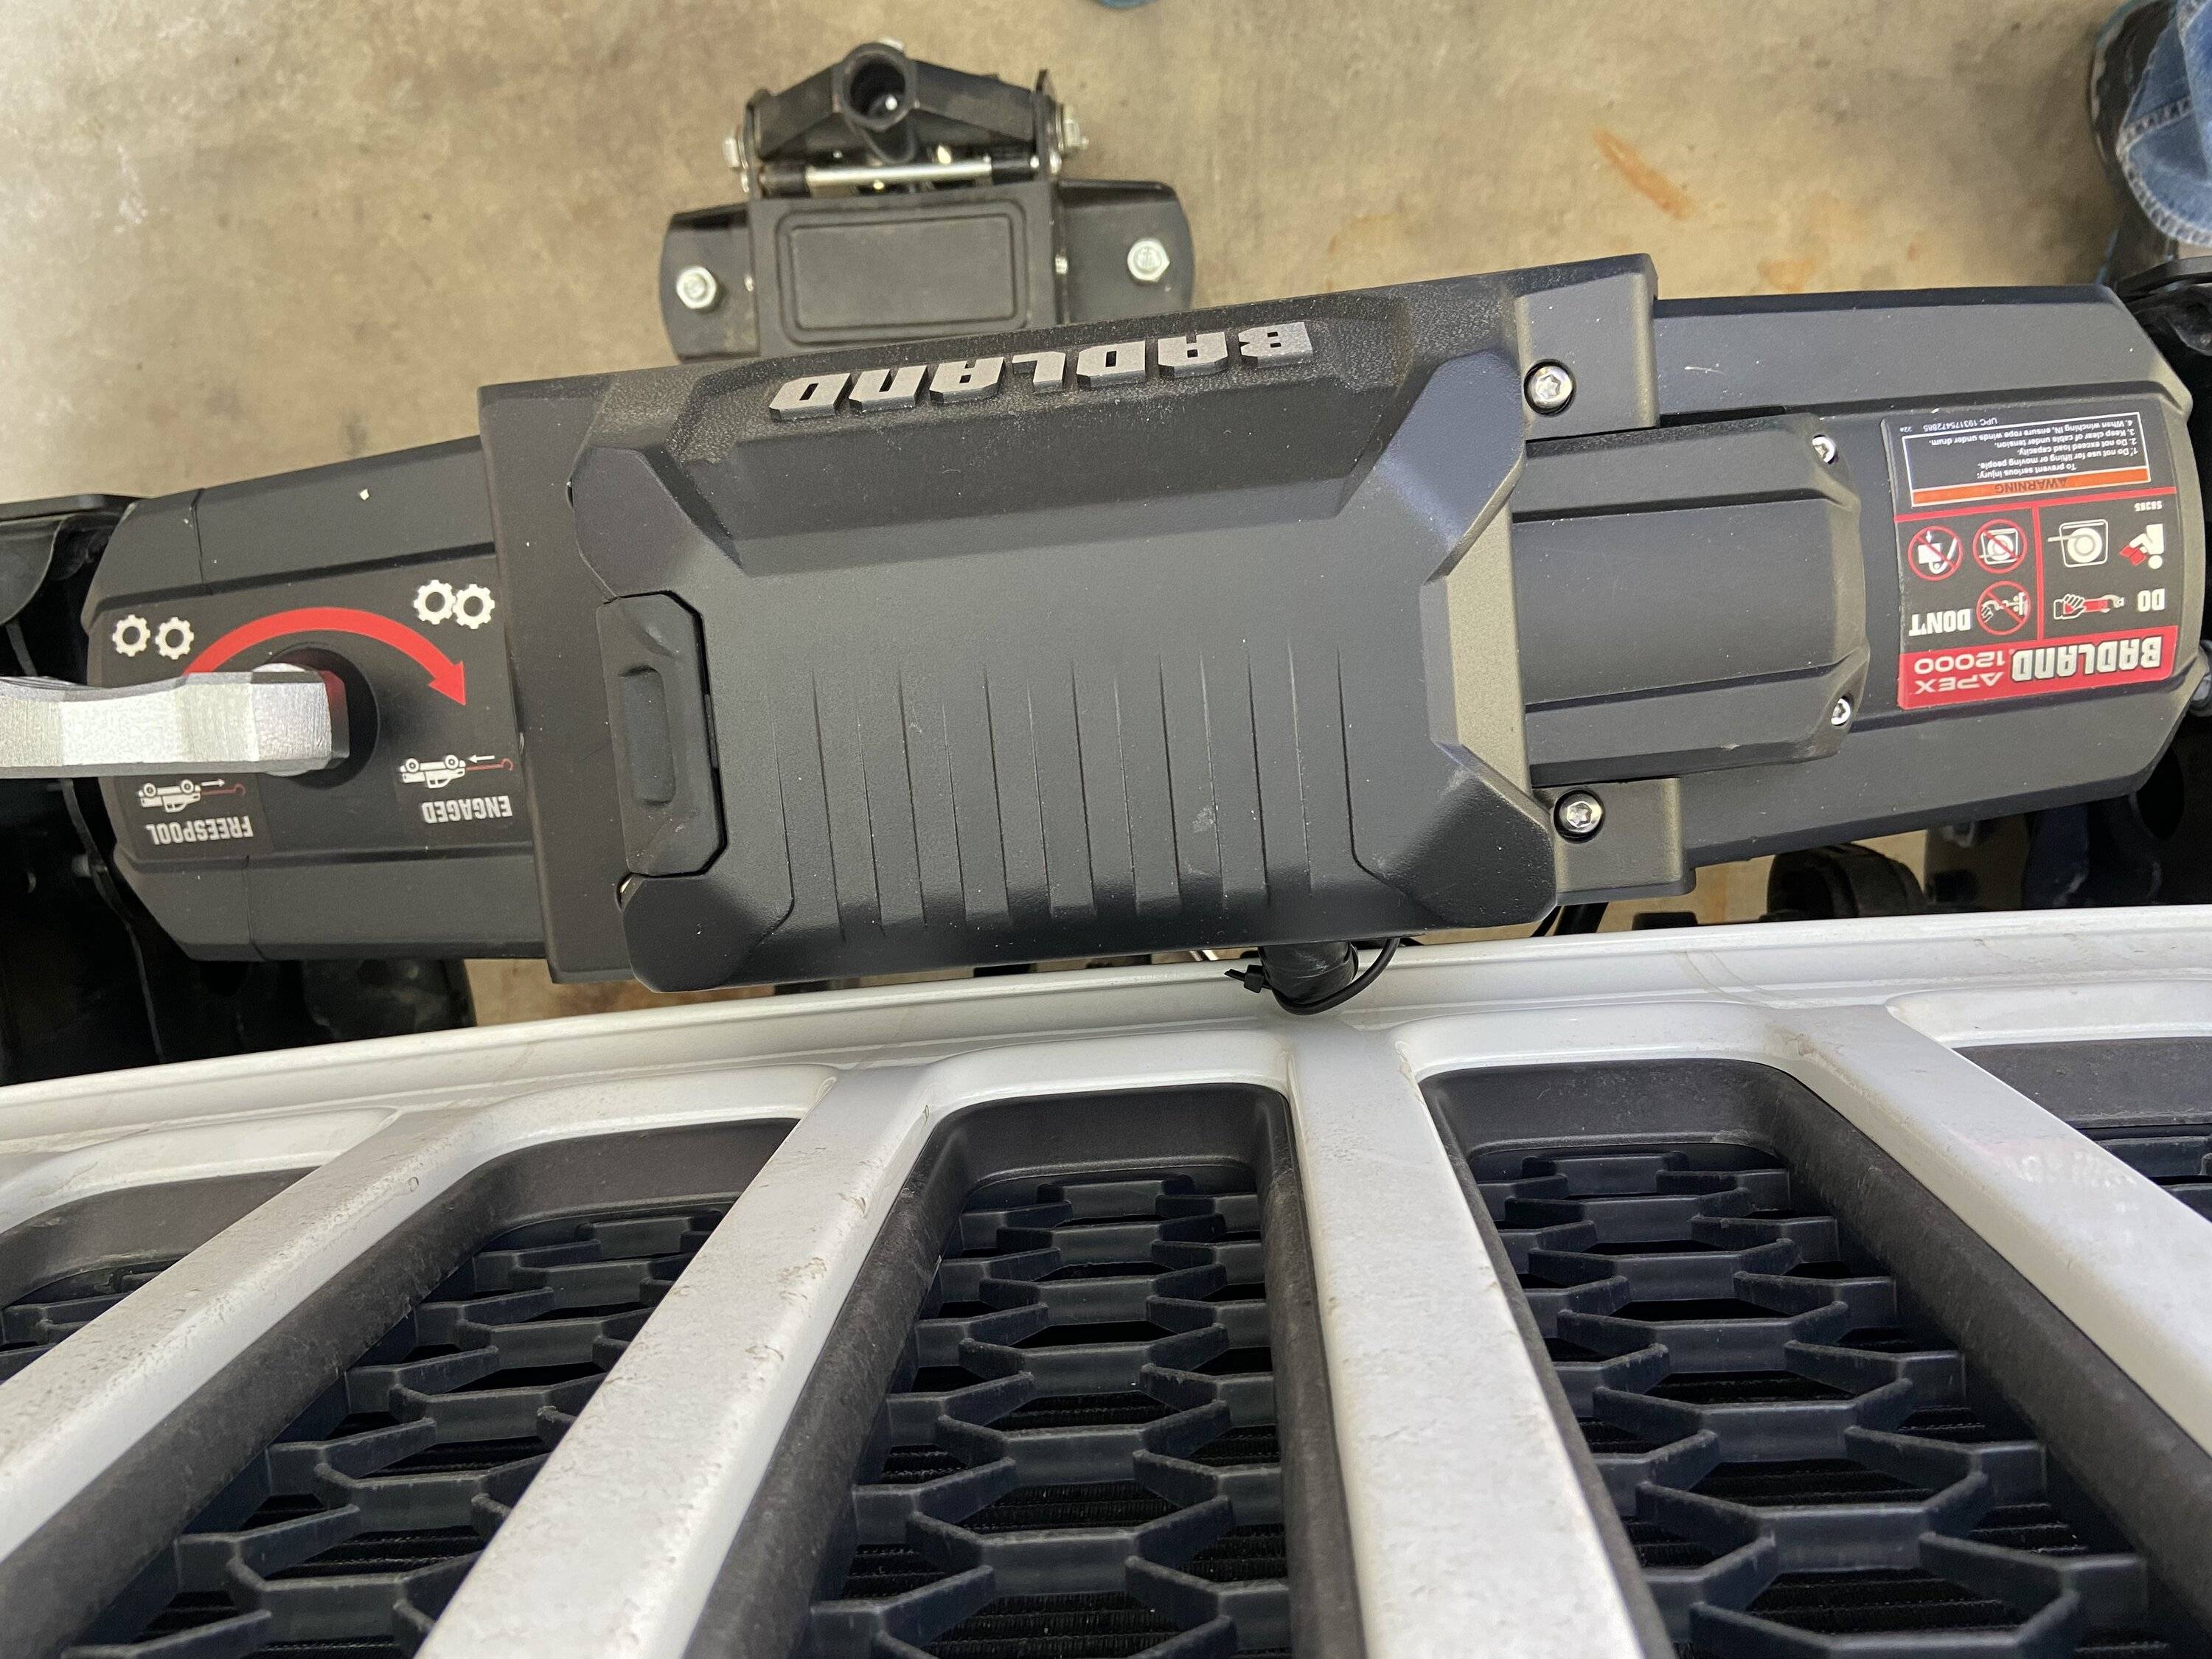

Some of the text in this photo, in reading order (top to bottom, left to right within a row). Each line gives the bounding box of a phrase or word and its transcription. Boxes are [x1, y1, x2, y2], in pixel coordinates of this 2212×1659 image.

[769, 322, 1312, 419] BADLAND
[1980, 417, 1997, 425] UPC
[2102, 420, 2124, 428] When
[2065, 423, 2100, 434] winching
[2106, 428, 2126, 437] Keep
[1979, 433, 2002, 441] winds
[2004, 429, 2022, 438] rope
[2085, 432, 2104, 440] clear
[2027, 437, 2051, 445] under
[2053, 435, 2073, 443] cable
[2053, 445, 2070, 453] load
[2072, 442, 2100, 451] exceed
[2050, 453, 2073, 462] lifting
[2004, 467, 2033, 476] serious
[2035, 463, 2065, 473] prevent
[1994, 478, 2059, 493] WARNING
[2138, 588, 2166, 612] DO
[1909, 608, 1971, 636] DON'T
[1914, 650, 2006, 673] 12000
[2011, 636, 2163, 683] BADLAND
[1916, 672, 2005, 695] APEX
[420, 795, 513, 824] ENGAGED
[145, 815, 254, 846] FREESPOOL
